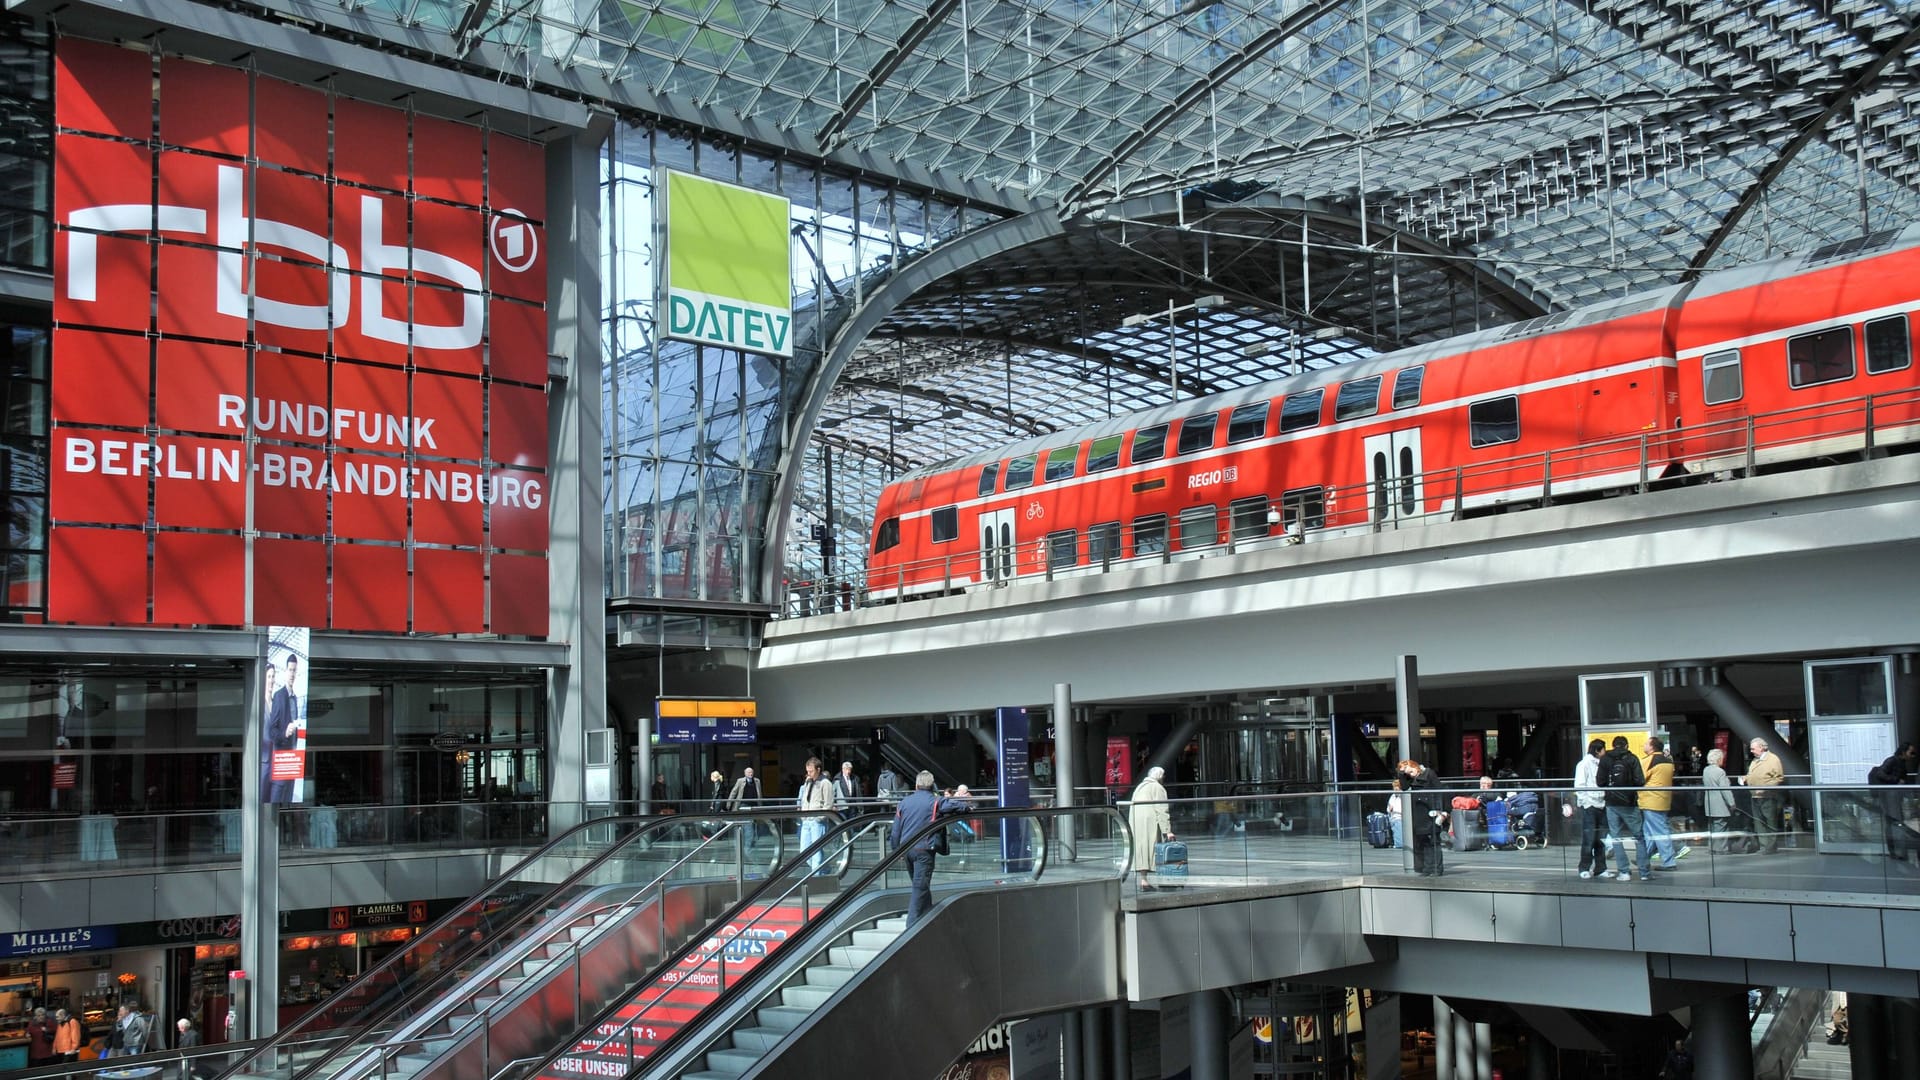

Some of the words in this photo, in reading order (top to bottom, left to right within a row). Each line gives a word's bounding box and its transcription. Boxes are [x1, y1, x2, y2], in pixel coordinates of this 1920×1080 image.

[68, 165, 484, 349] rbb
[670, 294, 790, 351] DATEV
[218, 394, 437, 450] RUNDFUNK
[65, 437, 542, 510] BERLIN-BRANDENBURG
[1188, 470, 1221, 489] REGIO
[1223, 466, 1237, 482] DB
[732, 718, 748, 728] 11-16
[1365, 723, 1375, 734] 14
[357, 904, 402, 915] FLAMMEN
[369, 915, 392, 925] GRILL
[159, 917, 217, 938] GOSCH
[31, 944, 73, 955] COOKIES
